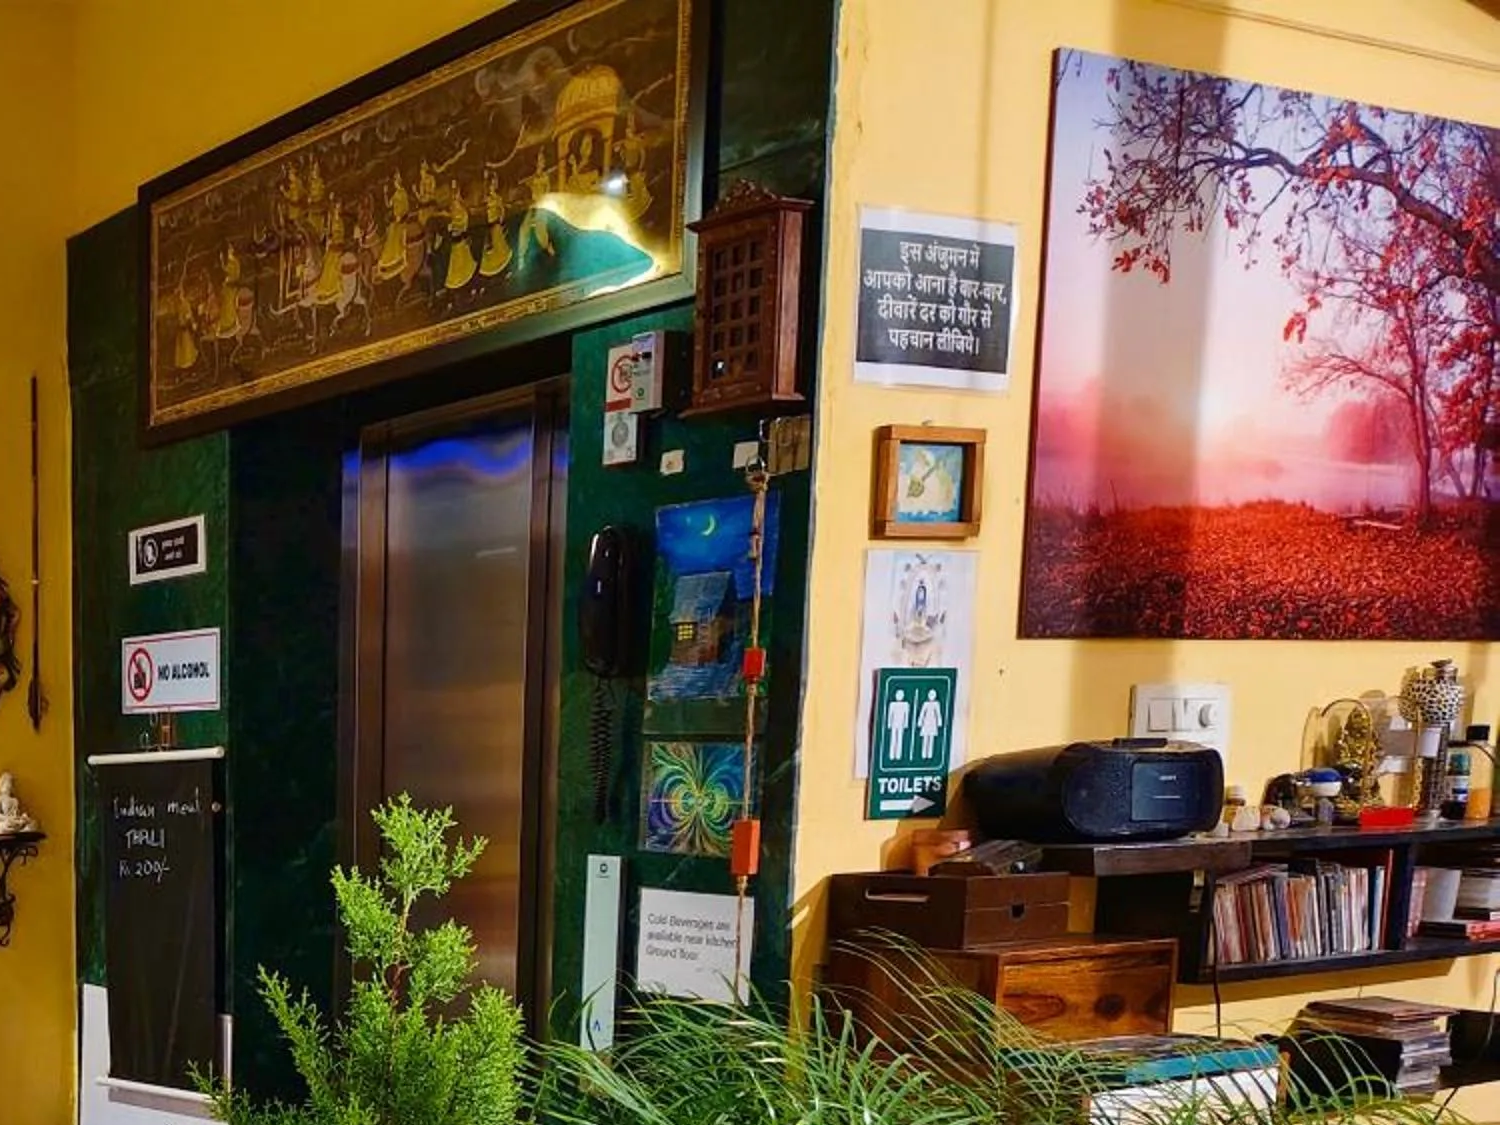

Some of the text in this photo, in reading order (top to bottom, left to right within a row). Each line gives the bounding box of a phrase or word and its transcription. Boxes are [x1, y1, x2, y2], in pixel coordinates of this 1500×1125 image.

[900, 241, 921, 265] इस
[864, 267, 912, 290] आपको
[915, 274, 946, 296] आना
[947, 271, 958, 297] है
[919, 302, 937, 322] दर
[939, 300, 956, 323] को
[981, 305, 992, 328] से
[888, 328, 934, 350] पहचान
[158, 662, 210, 680] NO ALCOHOL
[878, 776, 942, 793] TOILETS
[648, 913, 668, 924] Cold
[669, 915, 713, 930] Beverages
[647, 945, 677, 958] Ground
